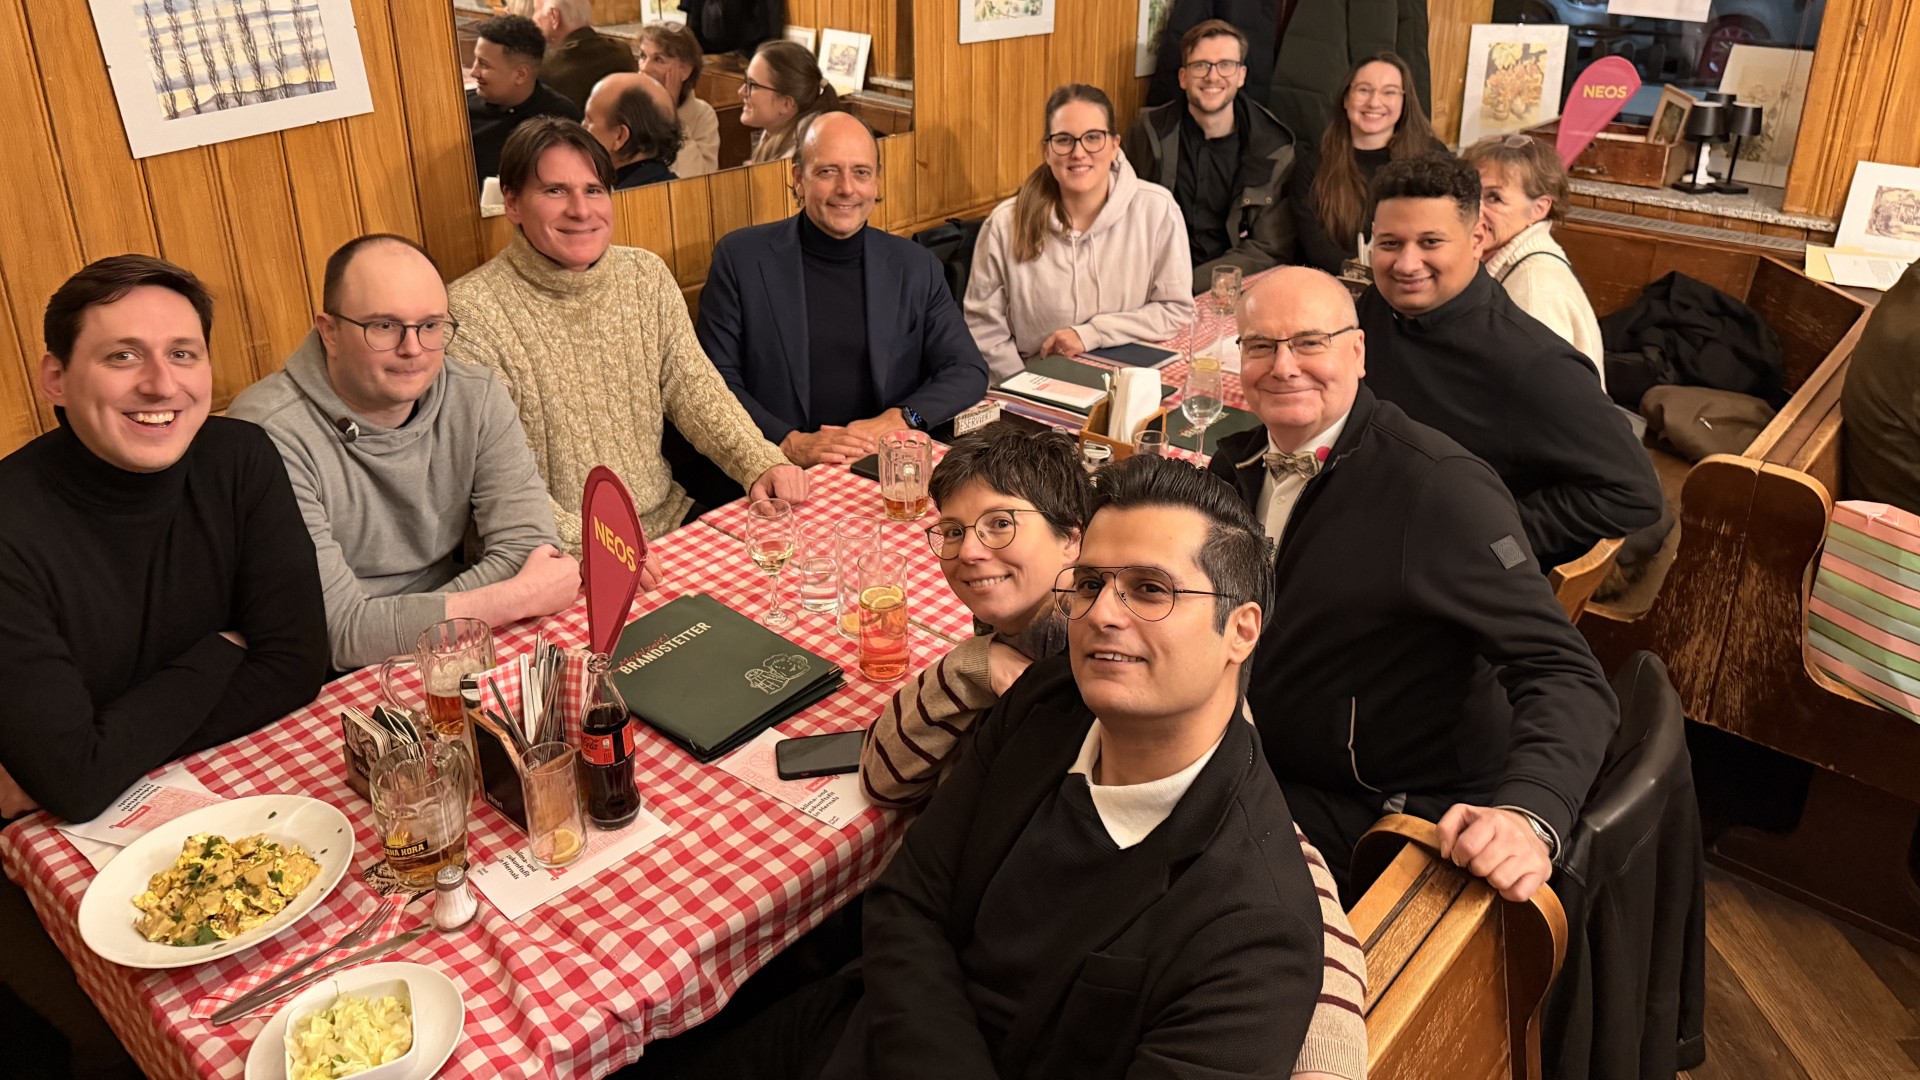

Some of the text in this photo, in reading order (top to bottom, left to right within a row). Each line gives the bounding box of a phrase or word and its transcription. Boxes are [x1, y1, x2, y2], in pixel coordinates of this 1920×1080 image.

[1583, 84, 1628, 99] NEOS
[593, 515, 637, 572] NEOS
[619, 621, 712, 675] BRANDSTETTER
